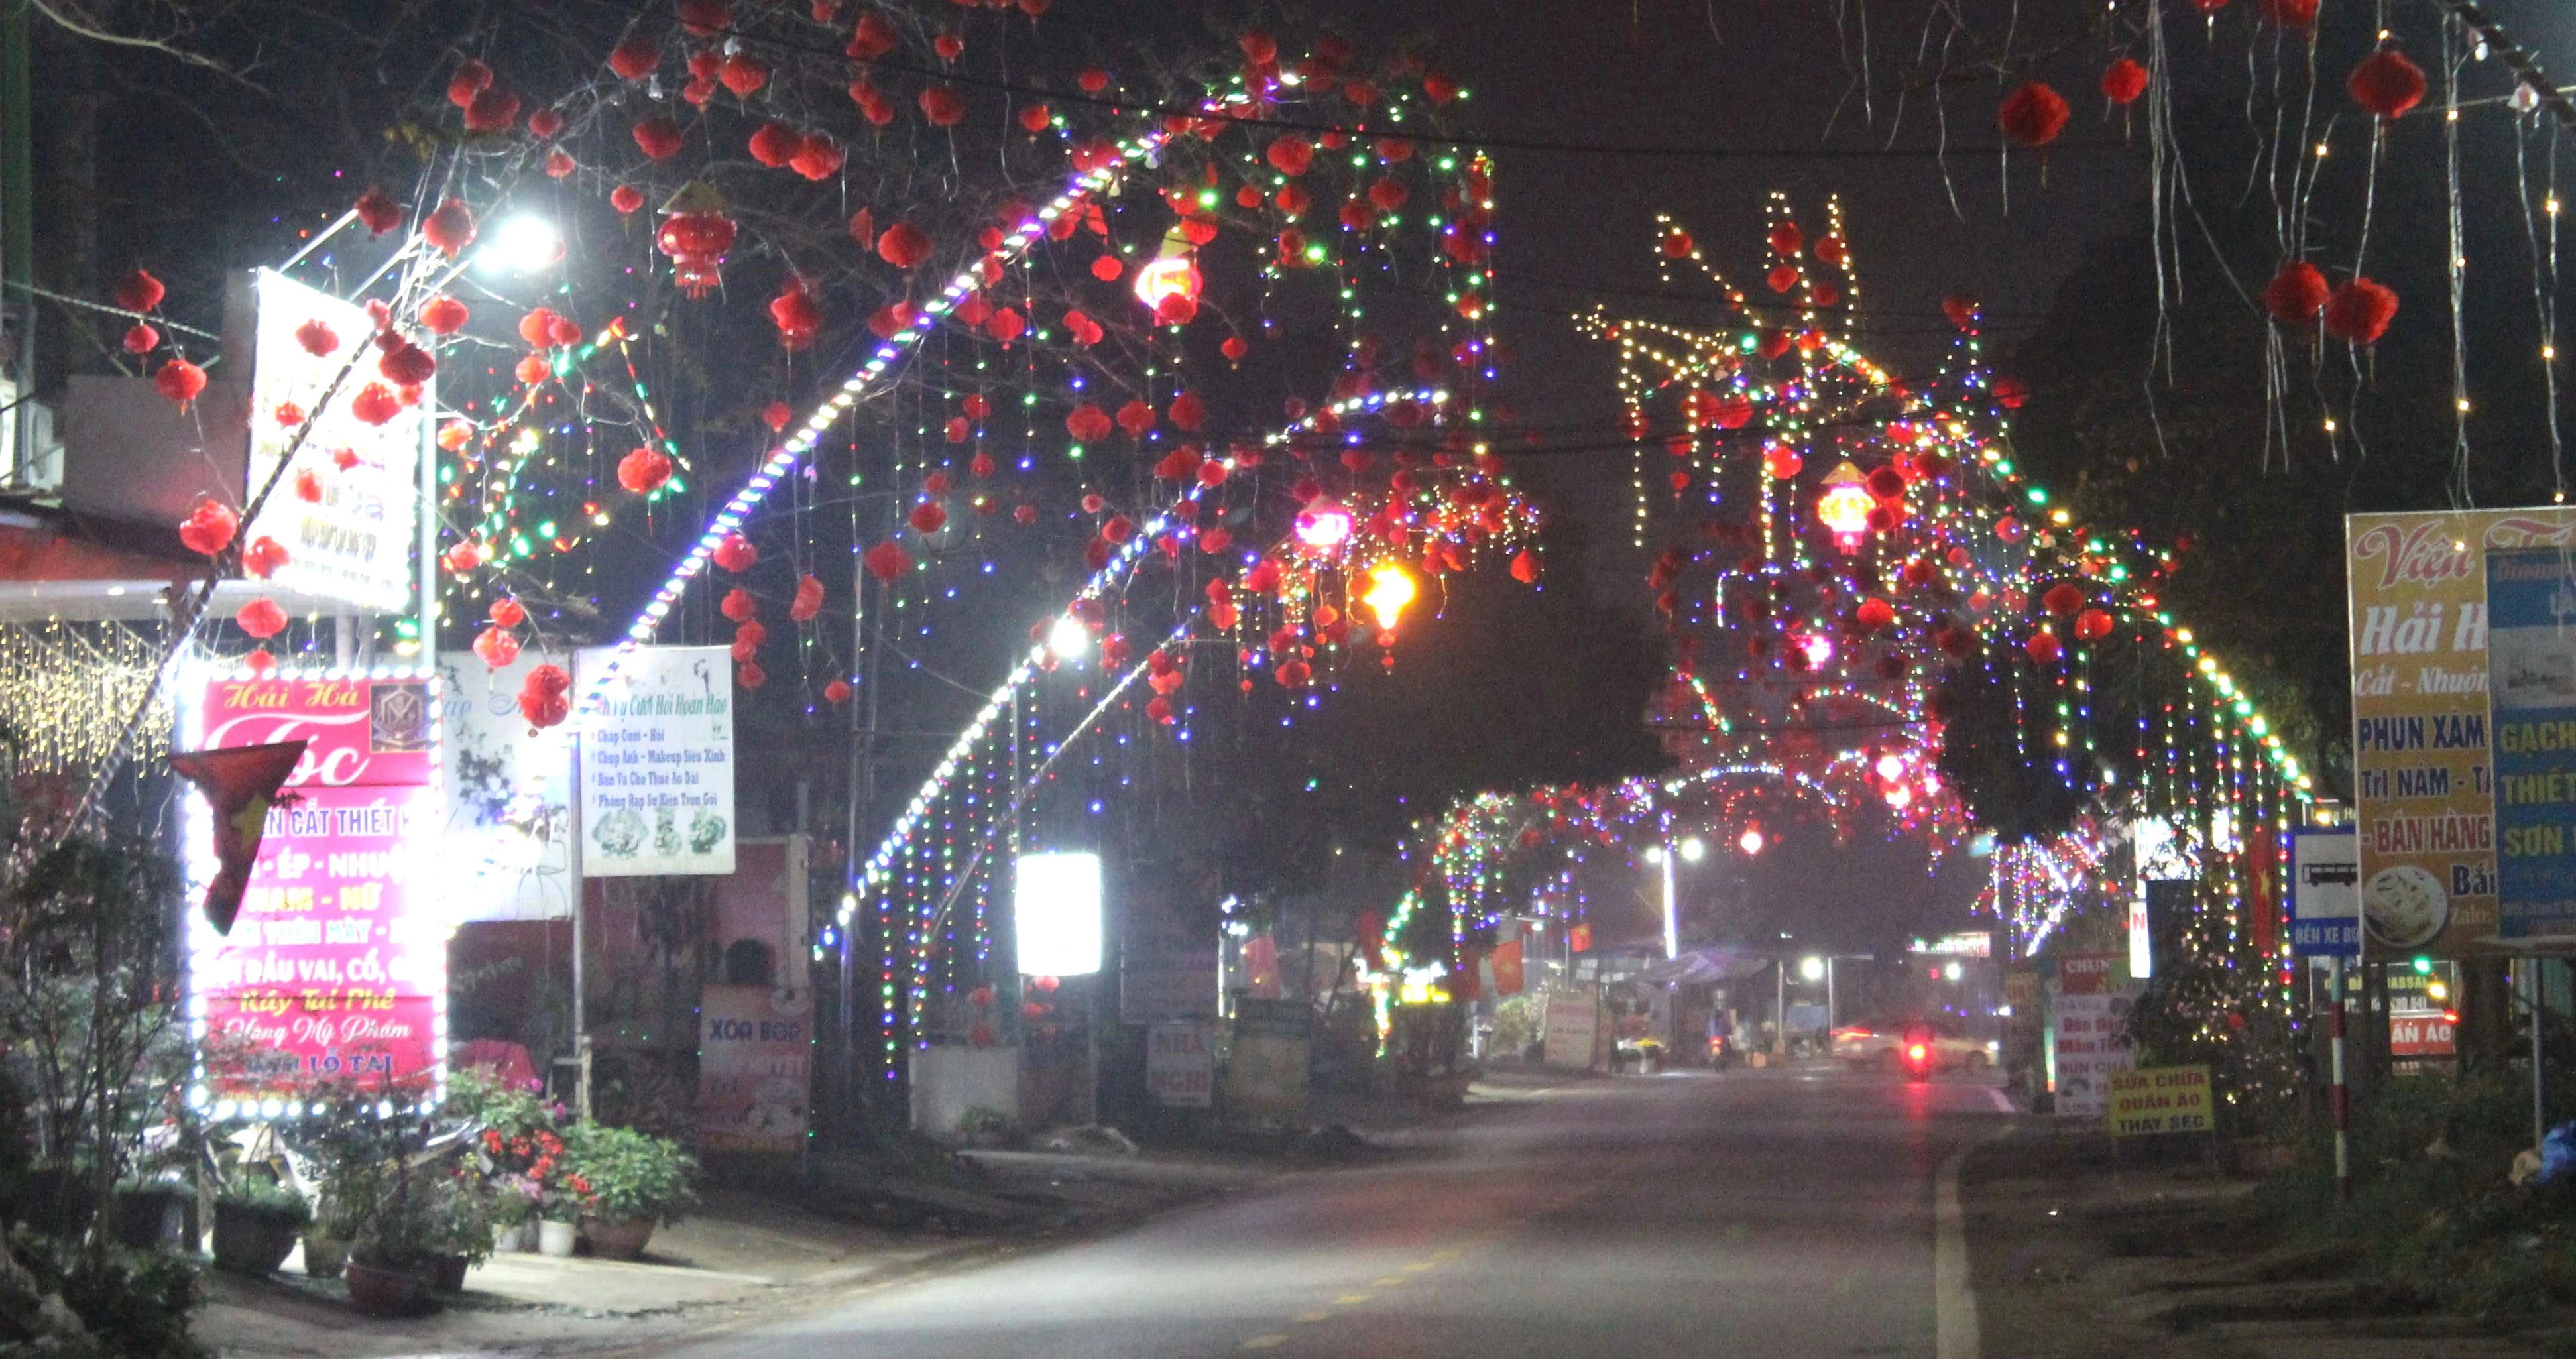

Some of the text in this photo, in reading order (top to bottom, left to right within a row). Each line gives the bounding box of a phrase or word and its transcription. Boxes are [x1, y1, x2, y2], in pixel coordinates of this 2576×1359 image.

[2355, 519, 2475, 591] Viện
[2360, 601, 2487, 655] Hải H
[223, 682, 289, 708] Hải
[2359, 716, 2424, 752] PHUN
[648, 750, 682, 768] Makeup
